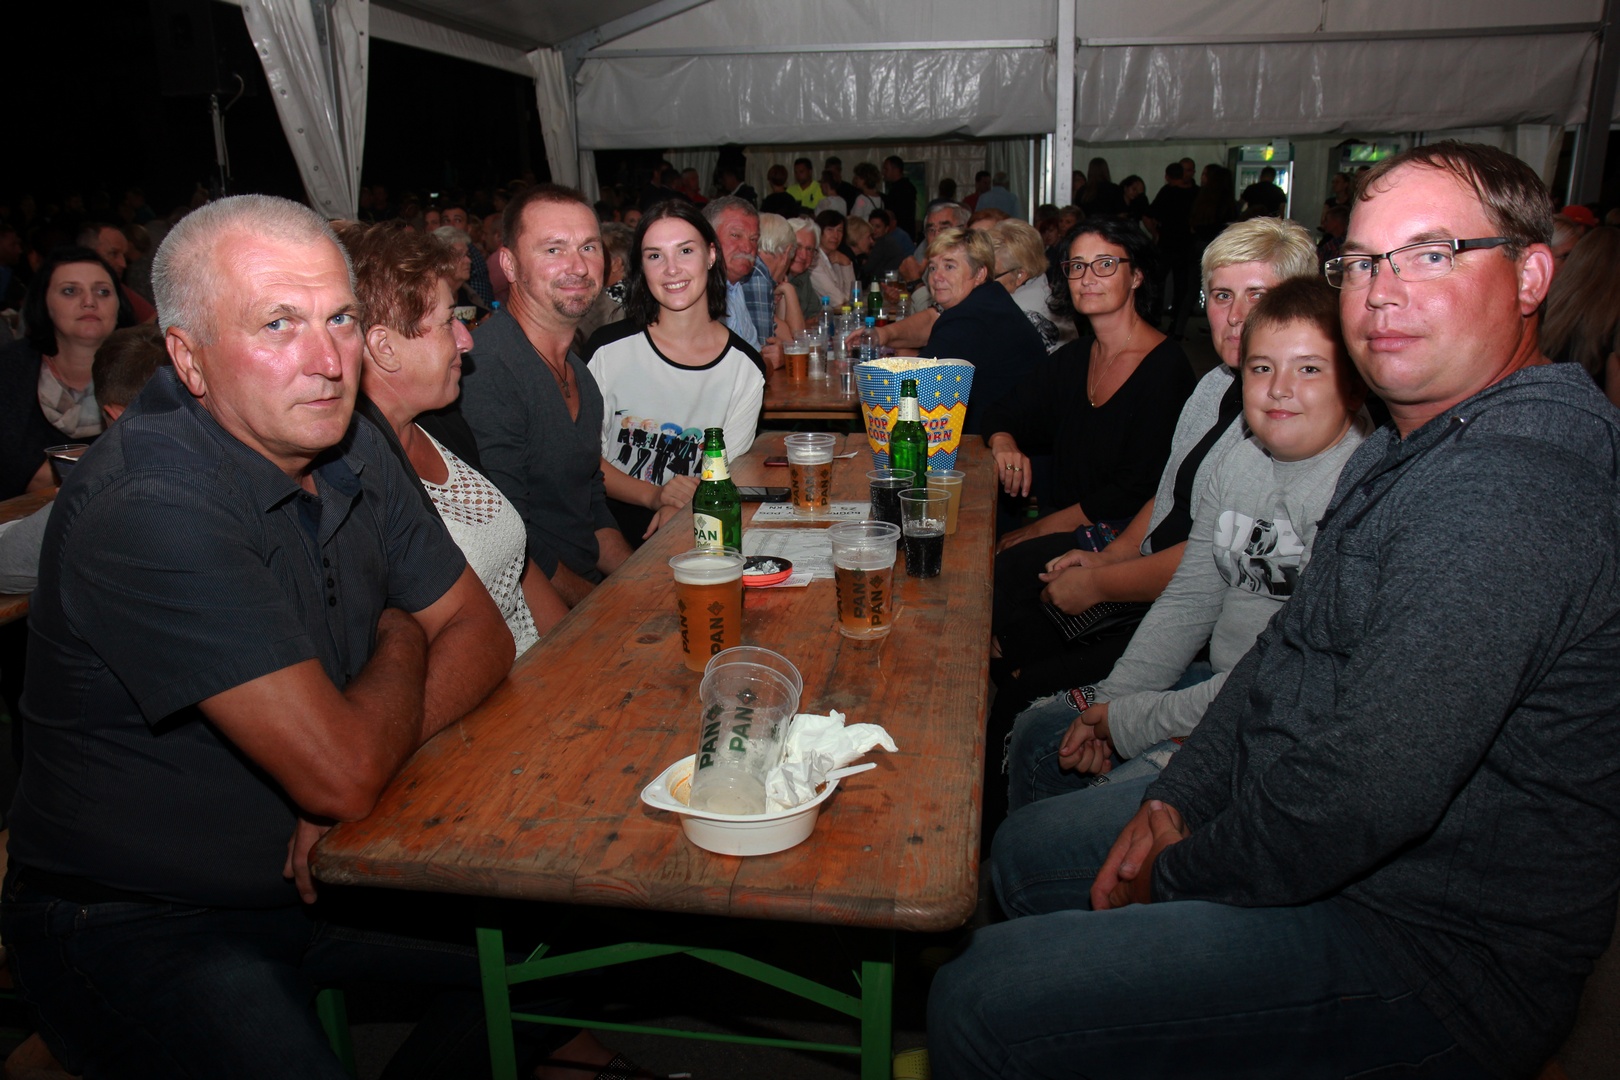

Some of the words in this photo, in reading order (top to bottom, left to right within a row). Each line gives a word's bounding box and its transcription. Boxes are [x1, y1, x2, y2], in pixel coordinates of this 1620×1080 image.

[868, 416, 889, 430] POP
[821, 480, 829, 506] PAN
[694, 527, 717, 541] PAN
[1213, 510, 1306, 556] STR
[853, 583, 866, 619] PAN
[871, 590, 883, 626] PAN
[680, 615, 691, 655] PAN
[709, 617, 724, 656] PAN
[699, 721, 721, 771] PAN
[729, 706, 754, 753] PAN
